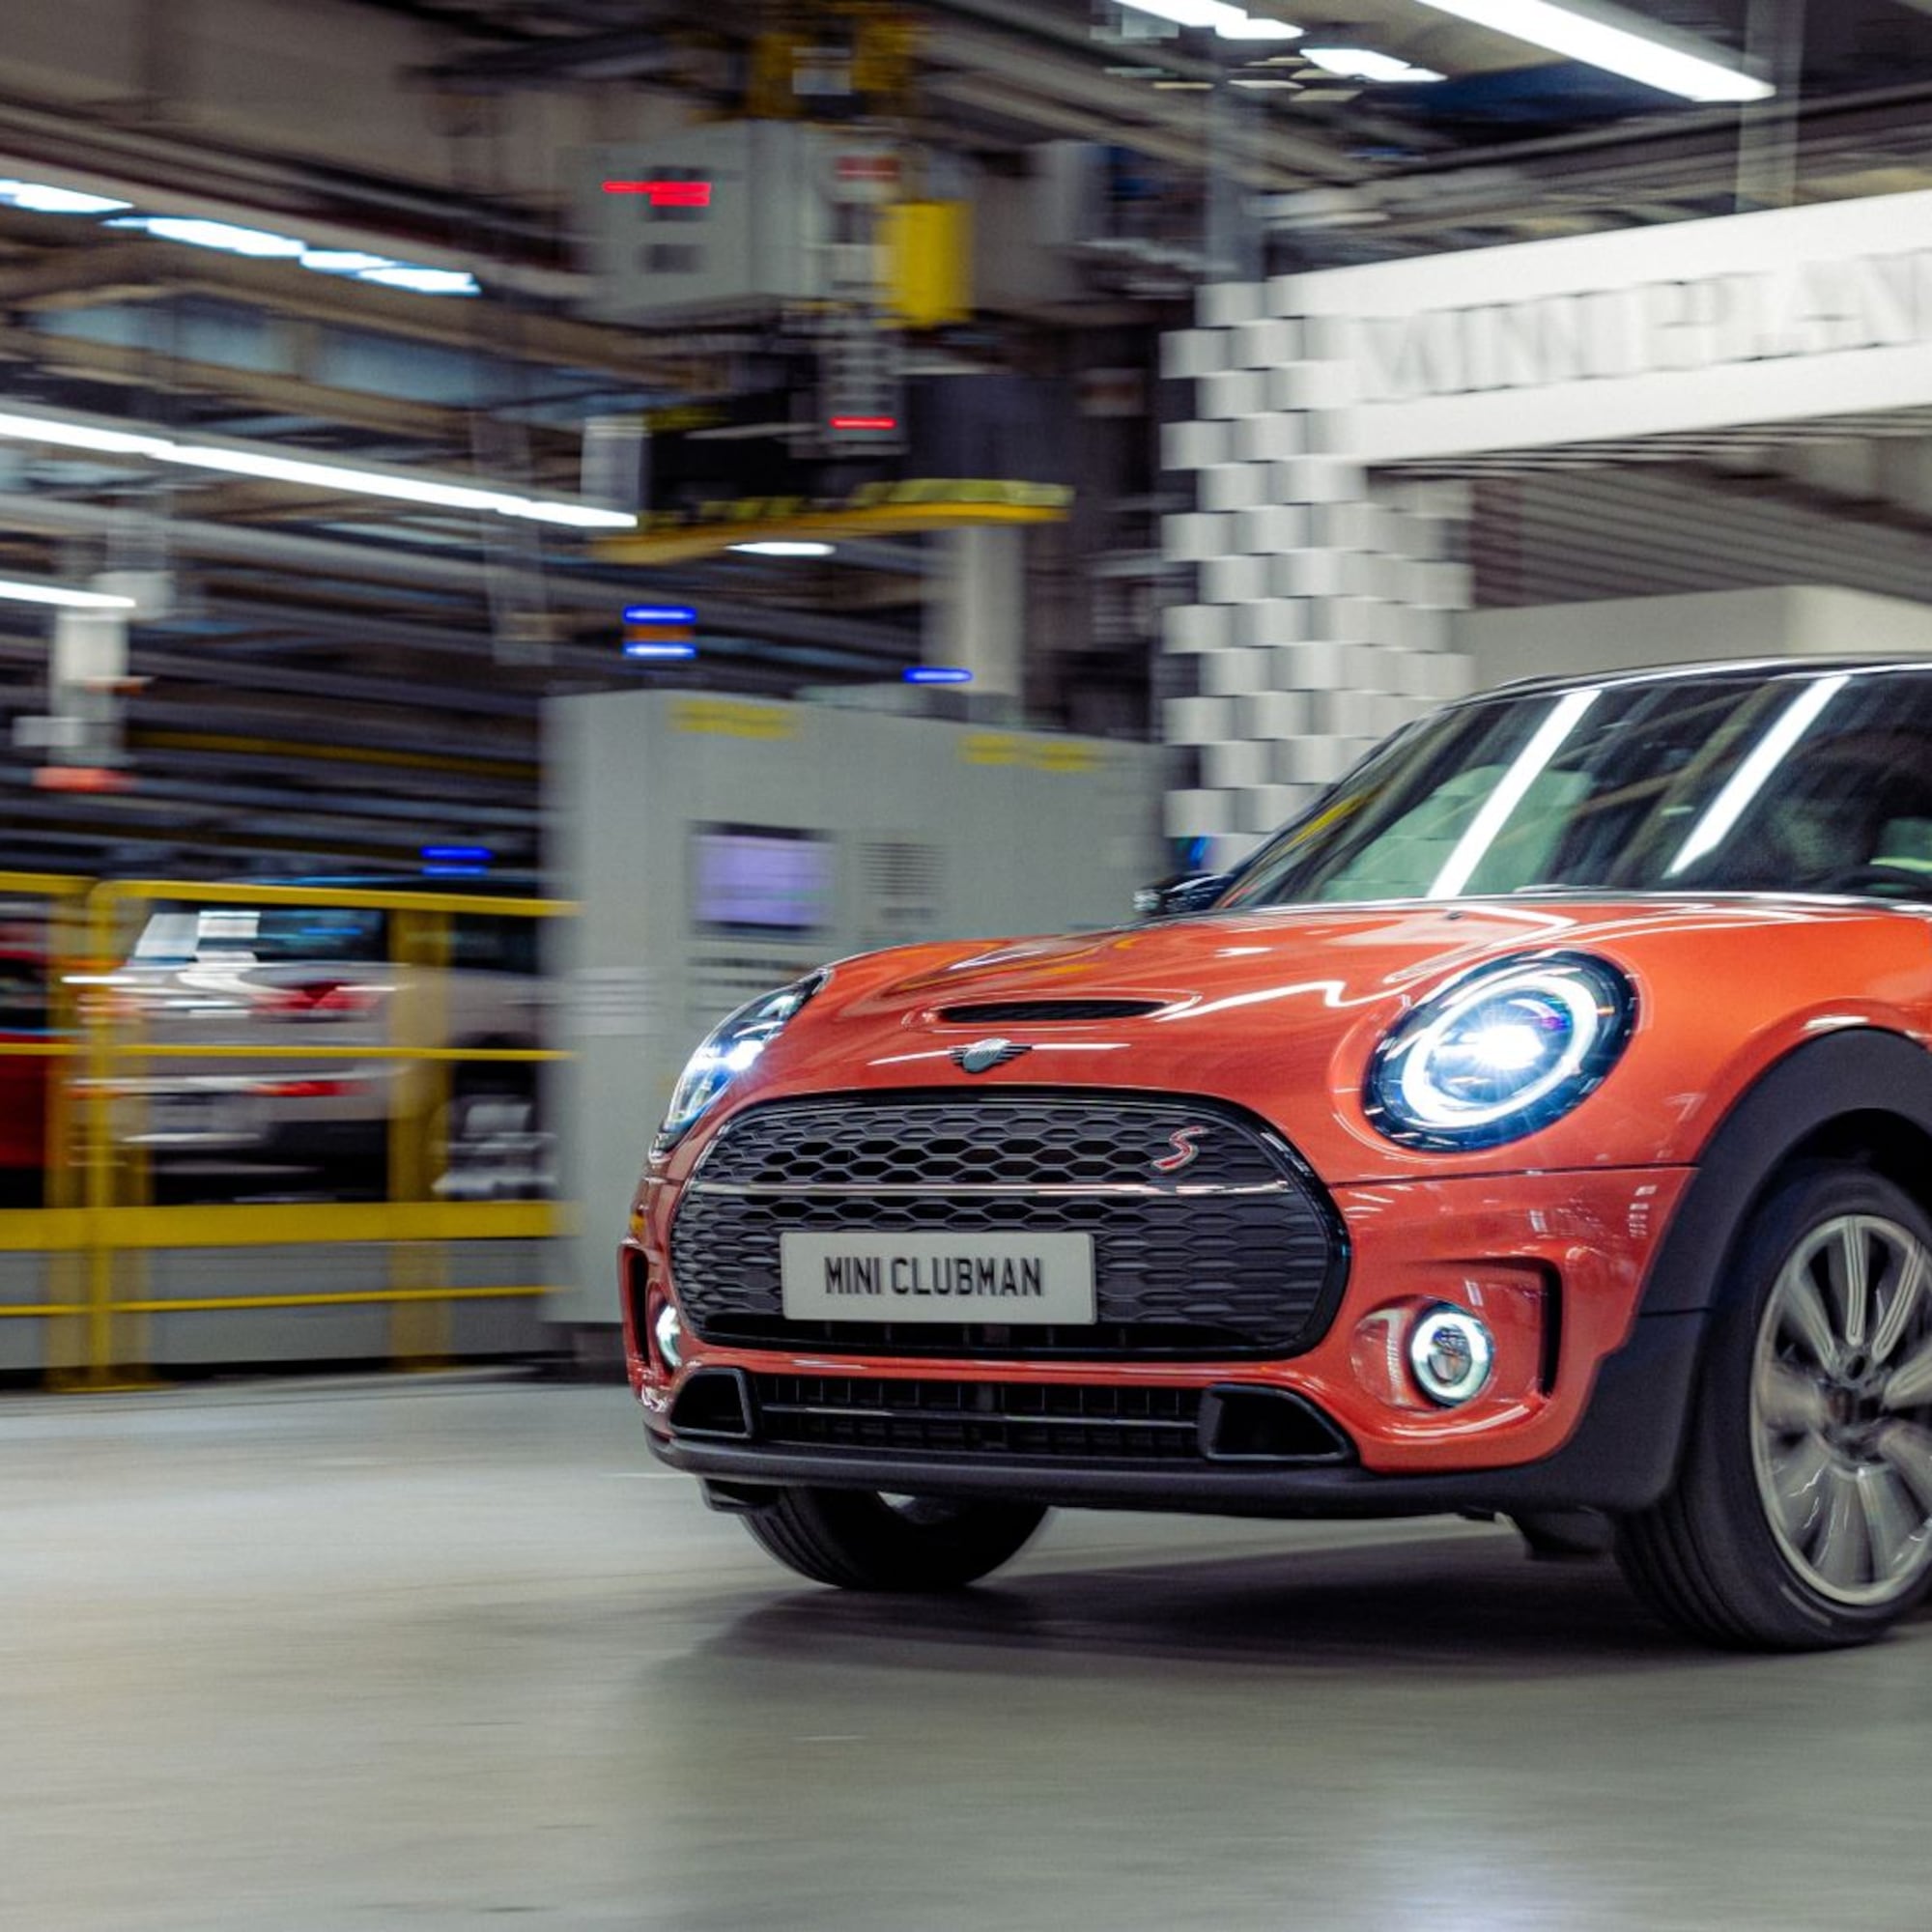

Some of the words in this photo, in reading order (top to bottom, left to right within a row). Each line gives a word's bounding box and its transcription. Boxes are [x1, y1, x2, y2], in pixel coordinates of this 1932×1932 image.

[1151, 1125, 1208, 1171] S
[824, 1257, 881, 1294] MINI
[891, 1257, 1042, 1296] CLUBMAN
